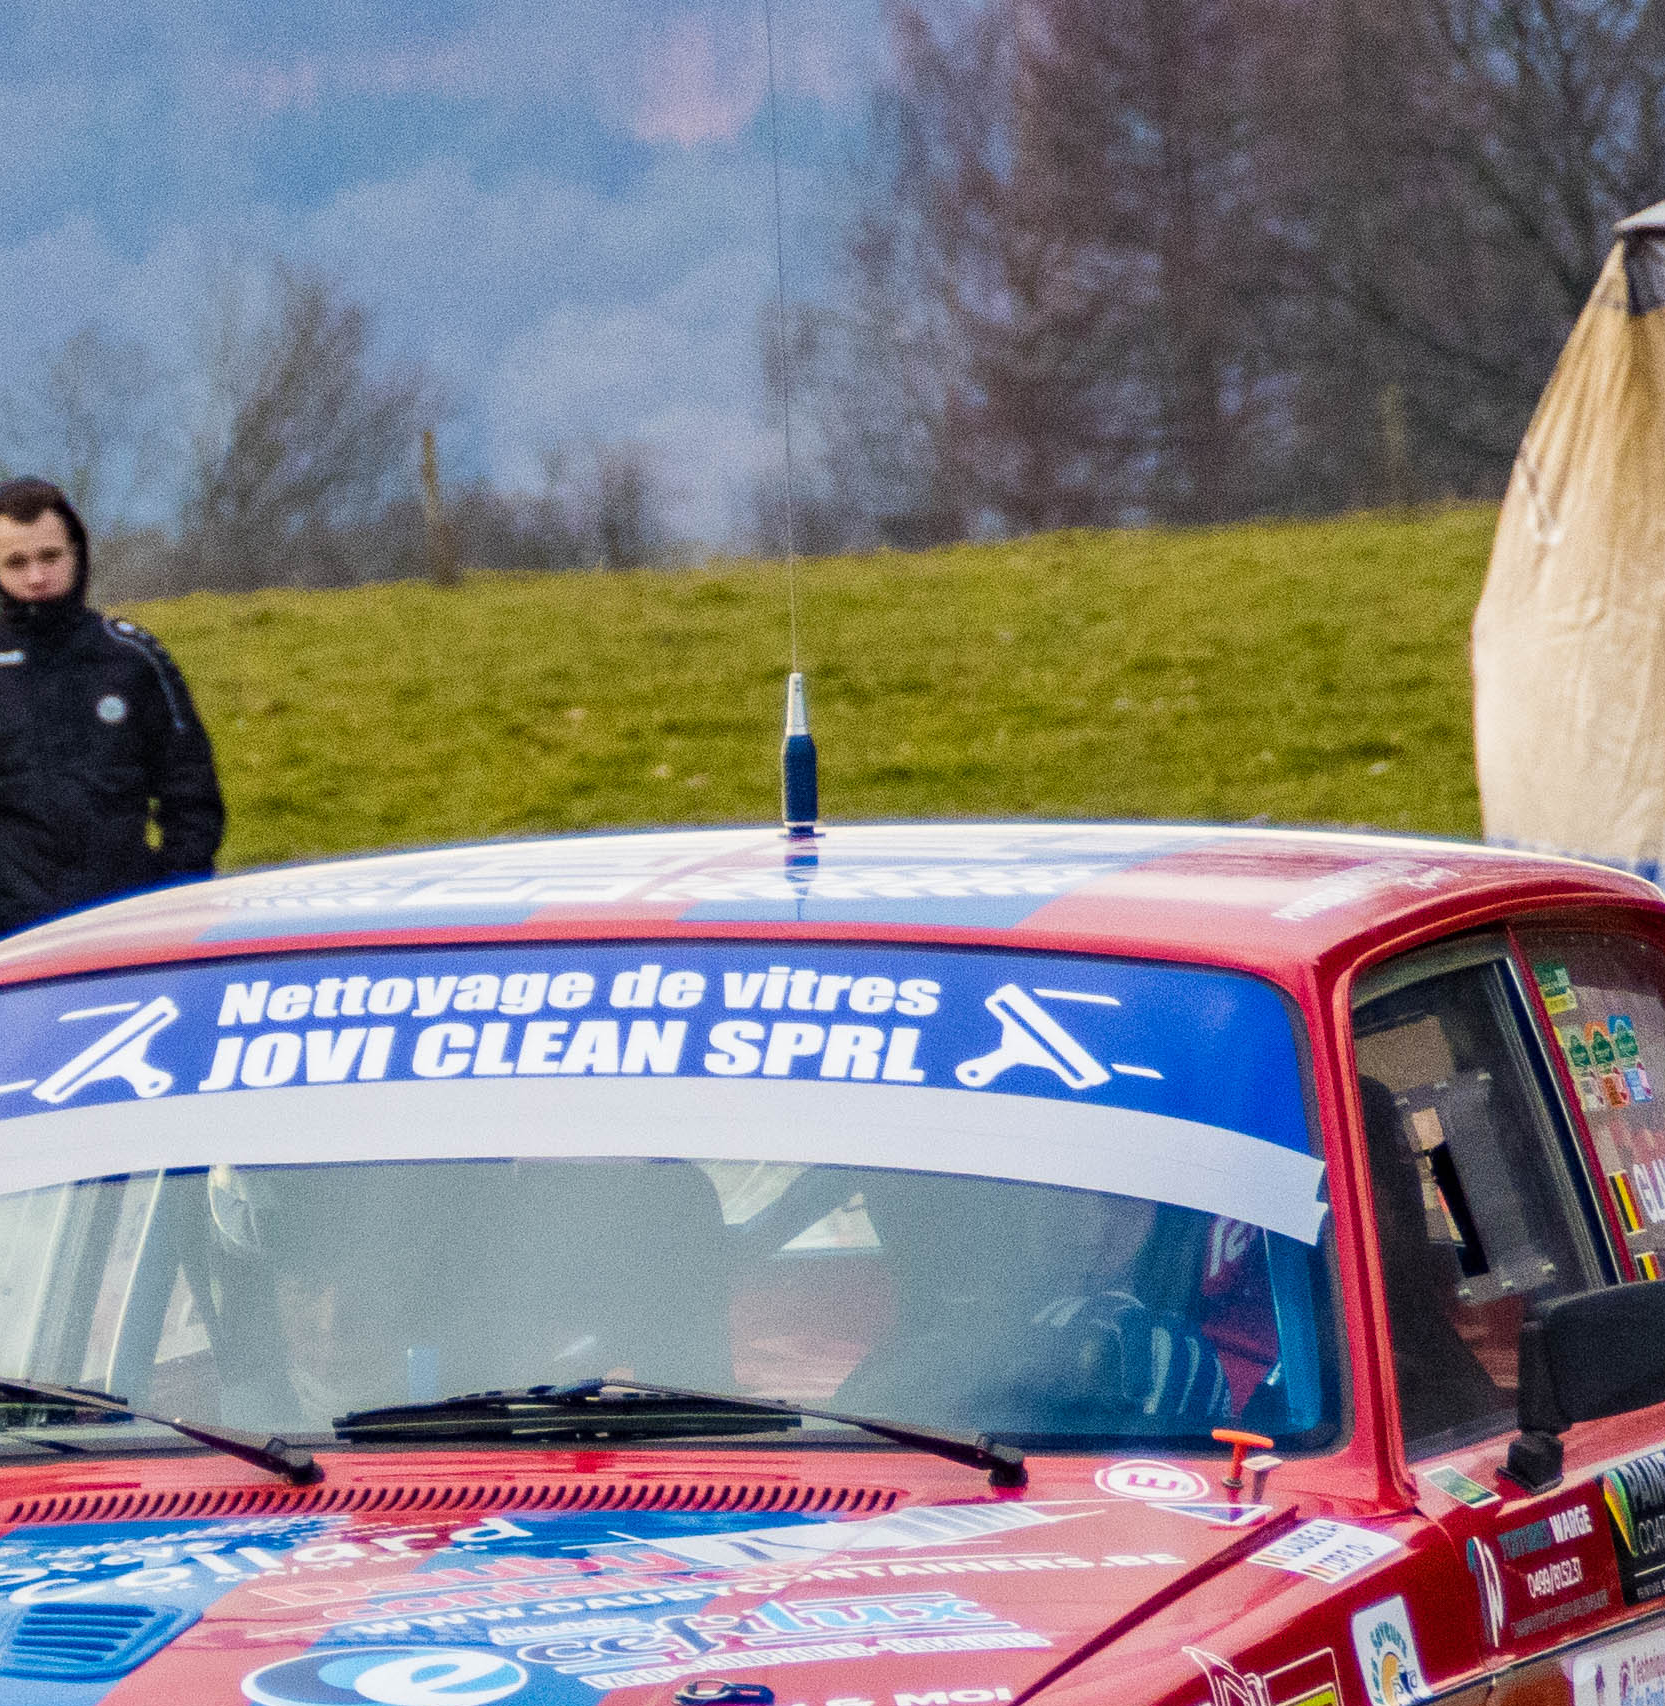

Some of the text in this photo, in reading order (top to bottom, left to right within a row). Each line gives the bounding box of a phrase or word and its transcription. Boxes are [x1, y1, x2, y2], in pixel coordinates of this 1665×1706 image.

[217, 964, 941, 1027] Nettoyage de vitres
[198, 1019, 925, 1092] JOVI CLEAN SPRL
[1548, 1503, 1594, 1545] WARGE
[8, 1517, 534, 1605] Collard
